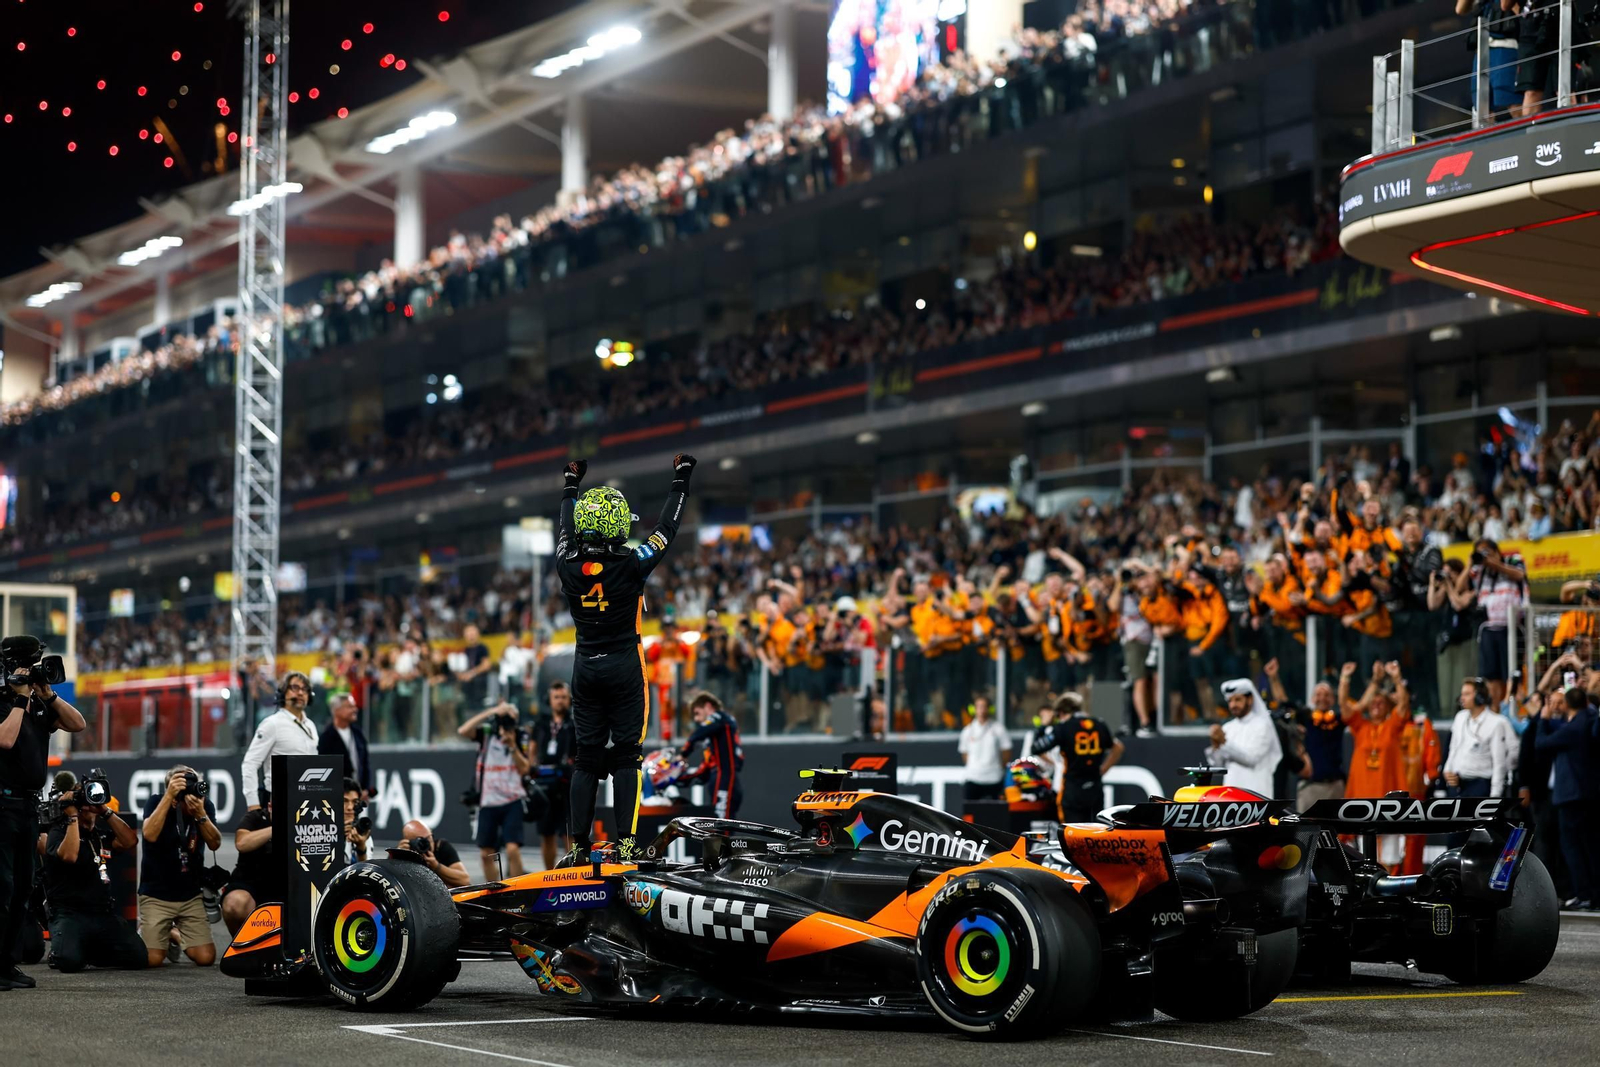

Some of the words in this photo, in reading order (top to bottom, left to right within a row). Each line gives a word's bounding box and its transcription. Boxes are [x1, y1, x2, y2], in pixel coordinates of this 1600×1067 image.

[1536, 142, 1560, 158] aws
[1489, 155, 1518, 174] PIRELLI
[1374, 178, 1411, 203] LVMH
[580, 582, 609, 612] 4
[1074, 731, 1102, 756] 81
[298, 768, 334, 782] F1
[800, 792, 859, 806] allwyn
[1162, 803, 1268, 827] VELO.COM
[1338, 799, 1502, 821] ORACLE
[295, 824, 338, 836] WORLD
[731, 839, 748, 848] okta
[880, 819, 989, 861] Gemini
[1084, 836, 1147, 851] Dropbox
[301, 844, 331, 855] 2025
[1090, 853, 1127, 864] Dash
[344, 869, 357, 880] P
[358, 868, 400, 900] ZERO
[543, 872, 577, 882] RICHARD
[560, 893, 573, 903] DP
[574, 891, 607, 902] WORLD
[920, 882, 959, 935] ZERO
[251, 919, 277, 928] workday
[1159, 912, 1185, 926] groq
[330, 983, 356, 1005] PIRELLI
[1003, 983, 1036, 1023] PIRELLI
